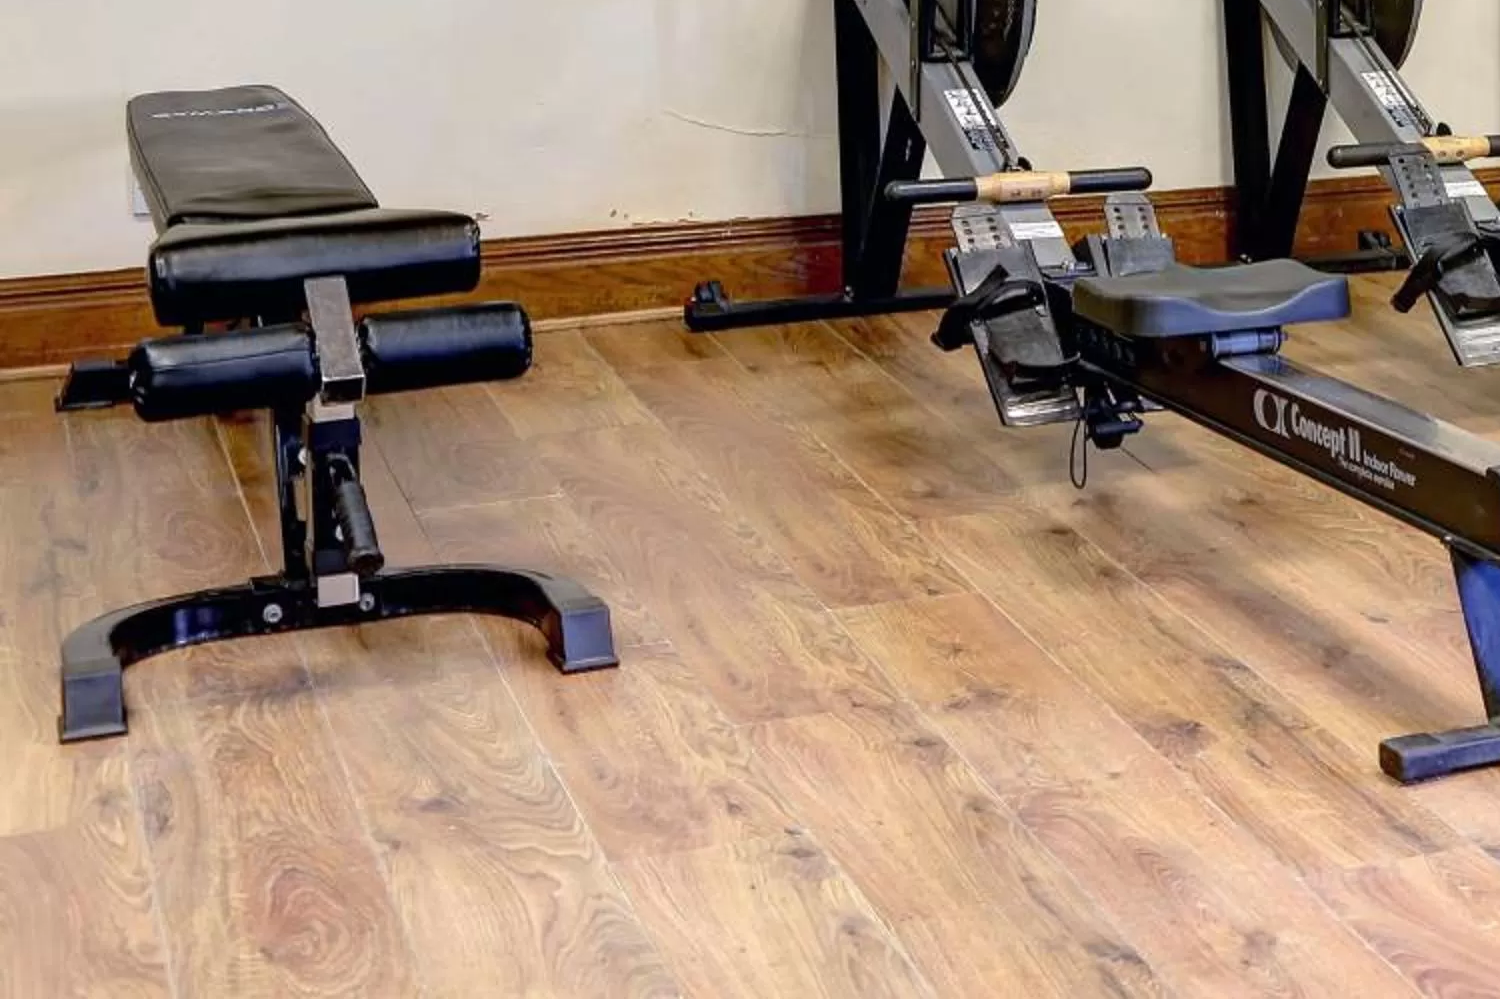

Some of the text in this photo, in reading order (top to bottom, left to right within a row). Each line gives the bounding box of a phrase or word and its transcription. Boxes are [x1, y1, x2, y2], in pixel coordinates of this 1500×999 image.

[1291, 402, 1416, 488] Concept II Indoor Rower
